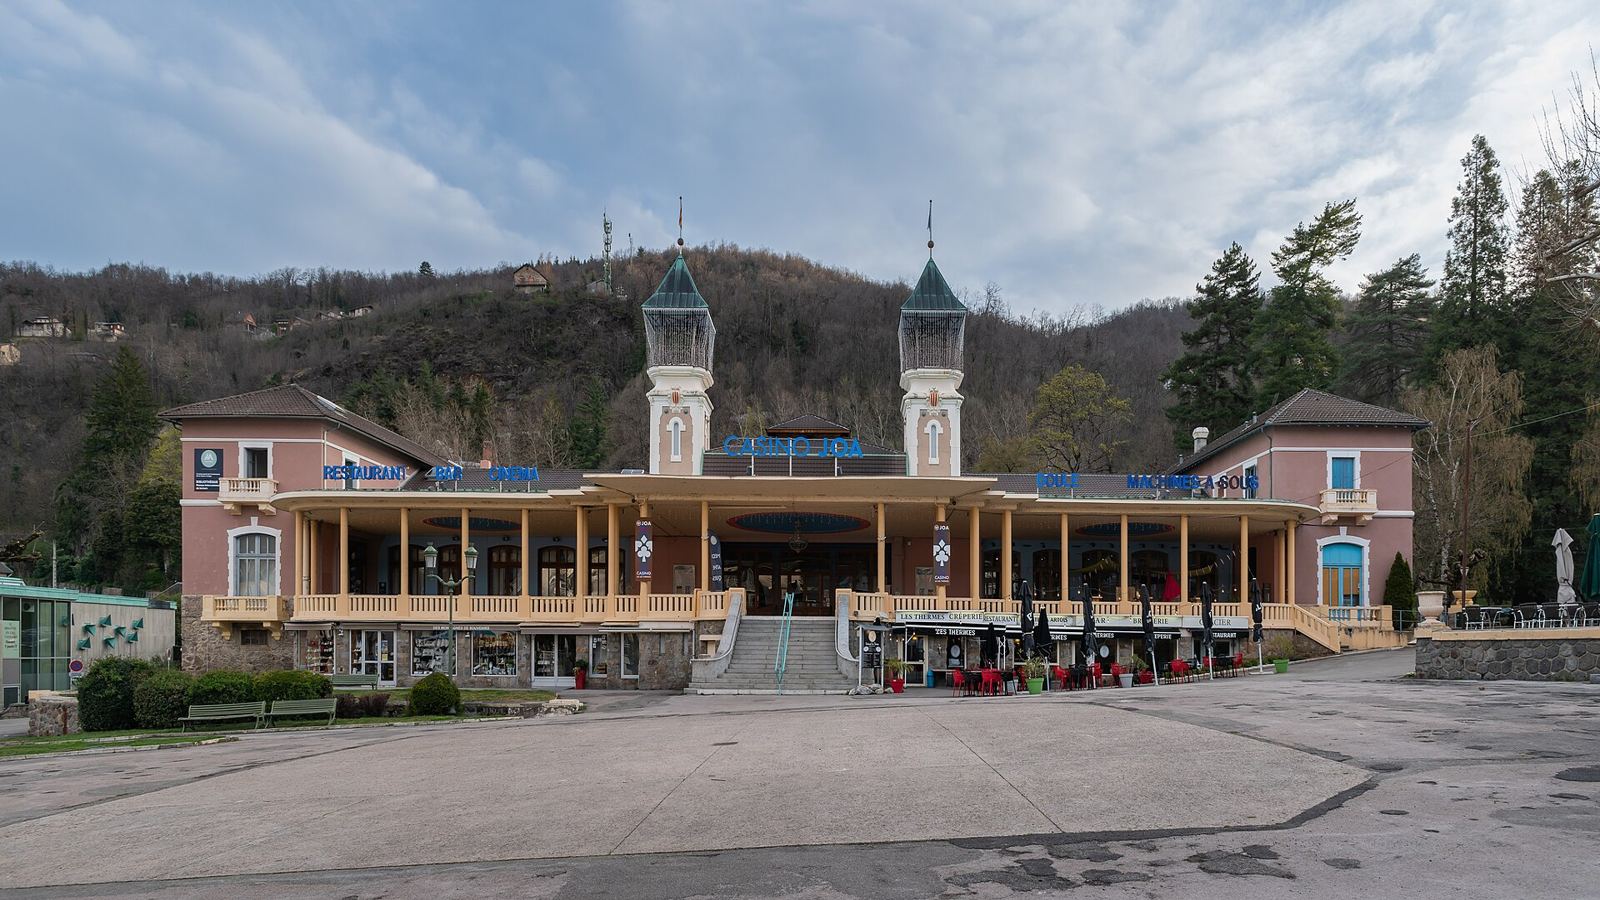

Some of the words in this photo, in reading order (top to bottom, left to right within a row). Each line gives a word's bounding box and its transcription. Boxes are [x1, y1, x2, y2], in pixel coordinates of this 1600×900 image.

[722, 434, 811, 458] CASINO
[818, 436, 864, 458] JOA
[324, 464, 407, 480] RESTAURANT
[435, 464, 462, 480] BAR
[489, 465, 539, 481] CINEMA
[1036, 472, 1080, 488] BOULE
[1127, 473, 1200, 489] MACHINES
[983, 614, 1018, 622] RESTAURANT
